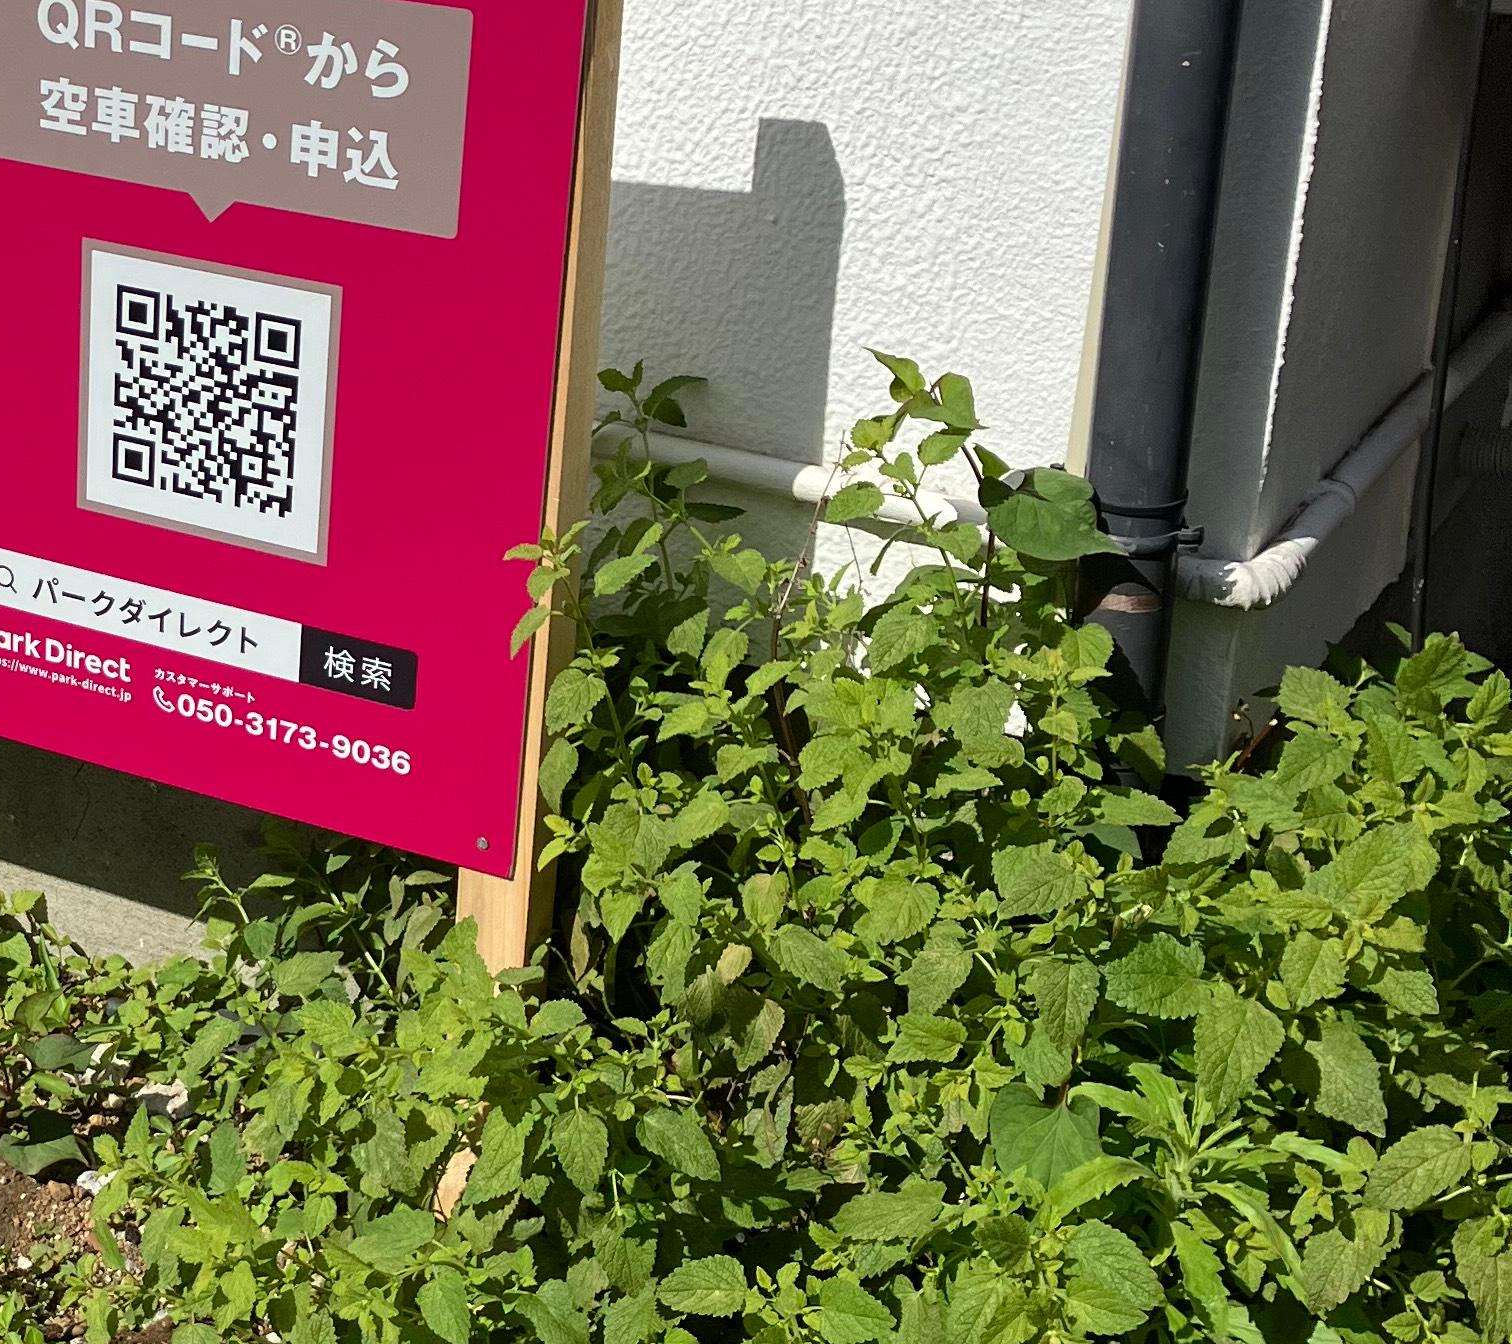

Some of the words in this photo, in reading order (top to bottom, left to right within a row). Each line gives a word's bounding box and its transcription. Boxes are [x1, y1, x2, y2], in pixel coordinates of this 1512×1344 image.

[39, 77, 400, 191] 空車確認・申込
[32, 577, 259, 655] パークダイレクト
[45, 636, 132, 683] Direct
[154, 668, 256, 704] カスタマーサポート
[323, 646, 392, 693] 検索
[177, 693, 412, 776] 050-3173-9036
